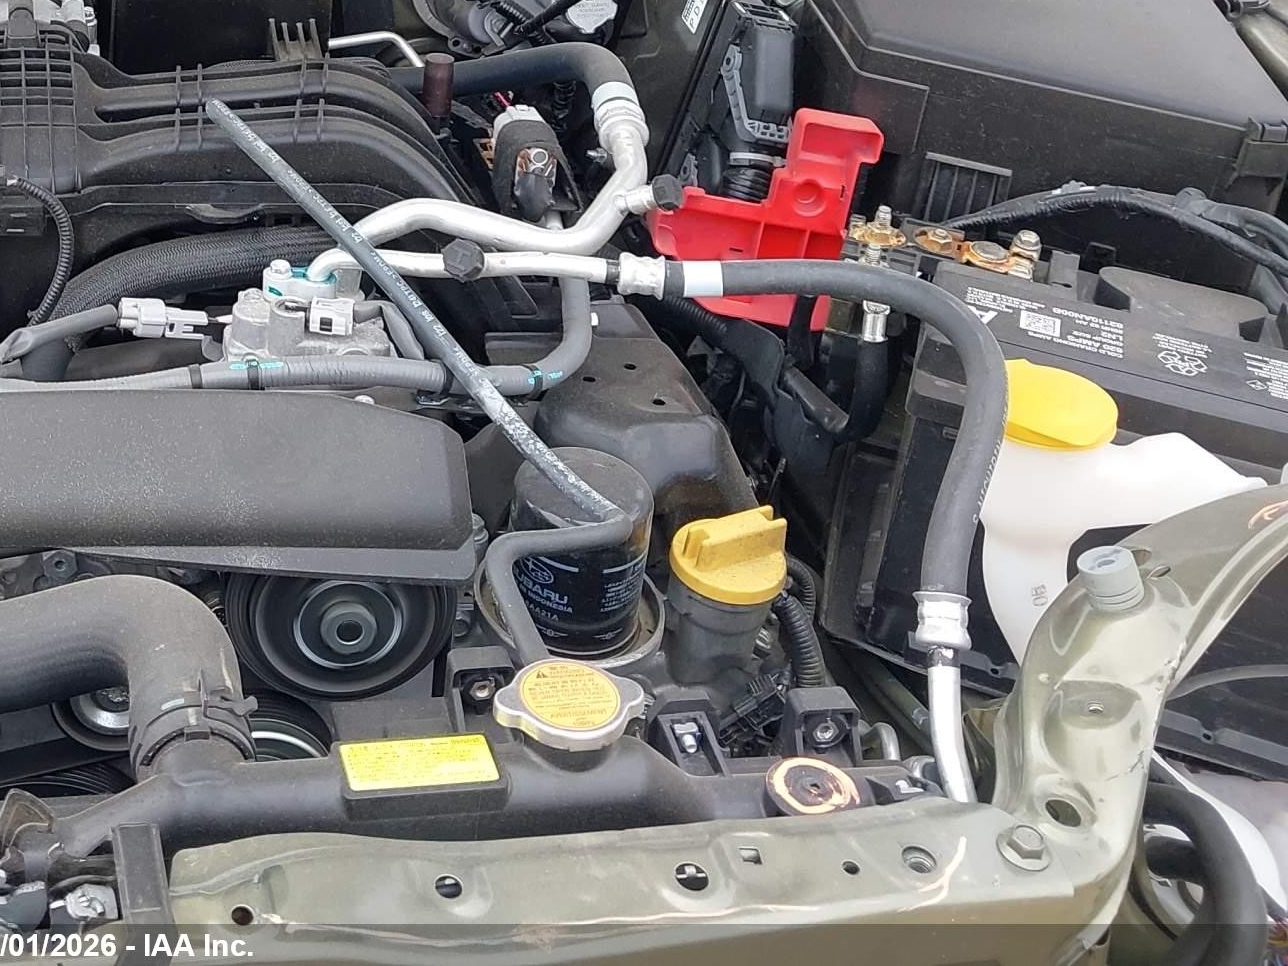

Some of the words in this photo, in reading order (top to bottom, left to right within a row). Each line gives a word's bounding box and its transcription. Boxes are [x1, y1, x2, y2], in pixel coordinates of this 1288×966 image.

[1027, 331, 1052, 341] AMPS
[1067, 335, 1101, 347] AMPS
[1053, 337, 1099, 354] CRANKING
[1099, 347, 1124, 359] COLD
